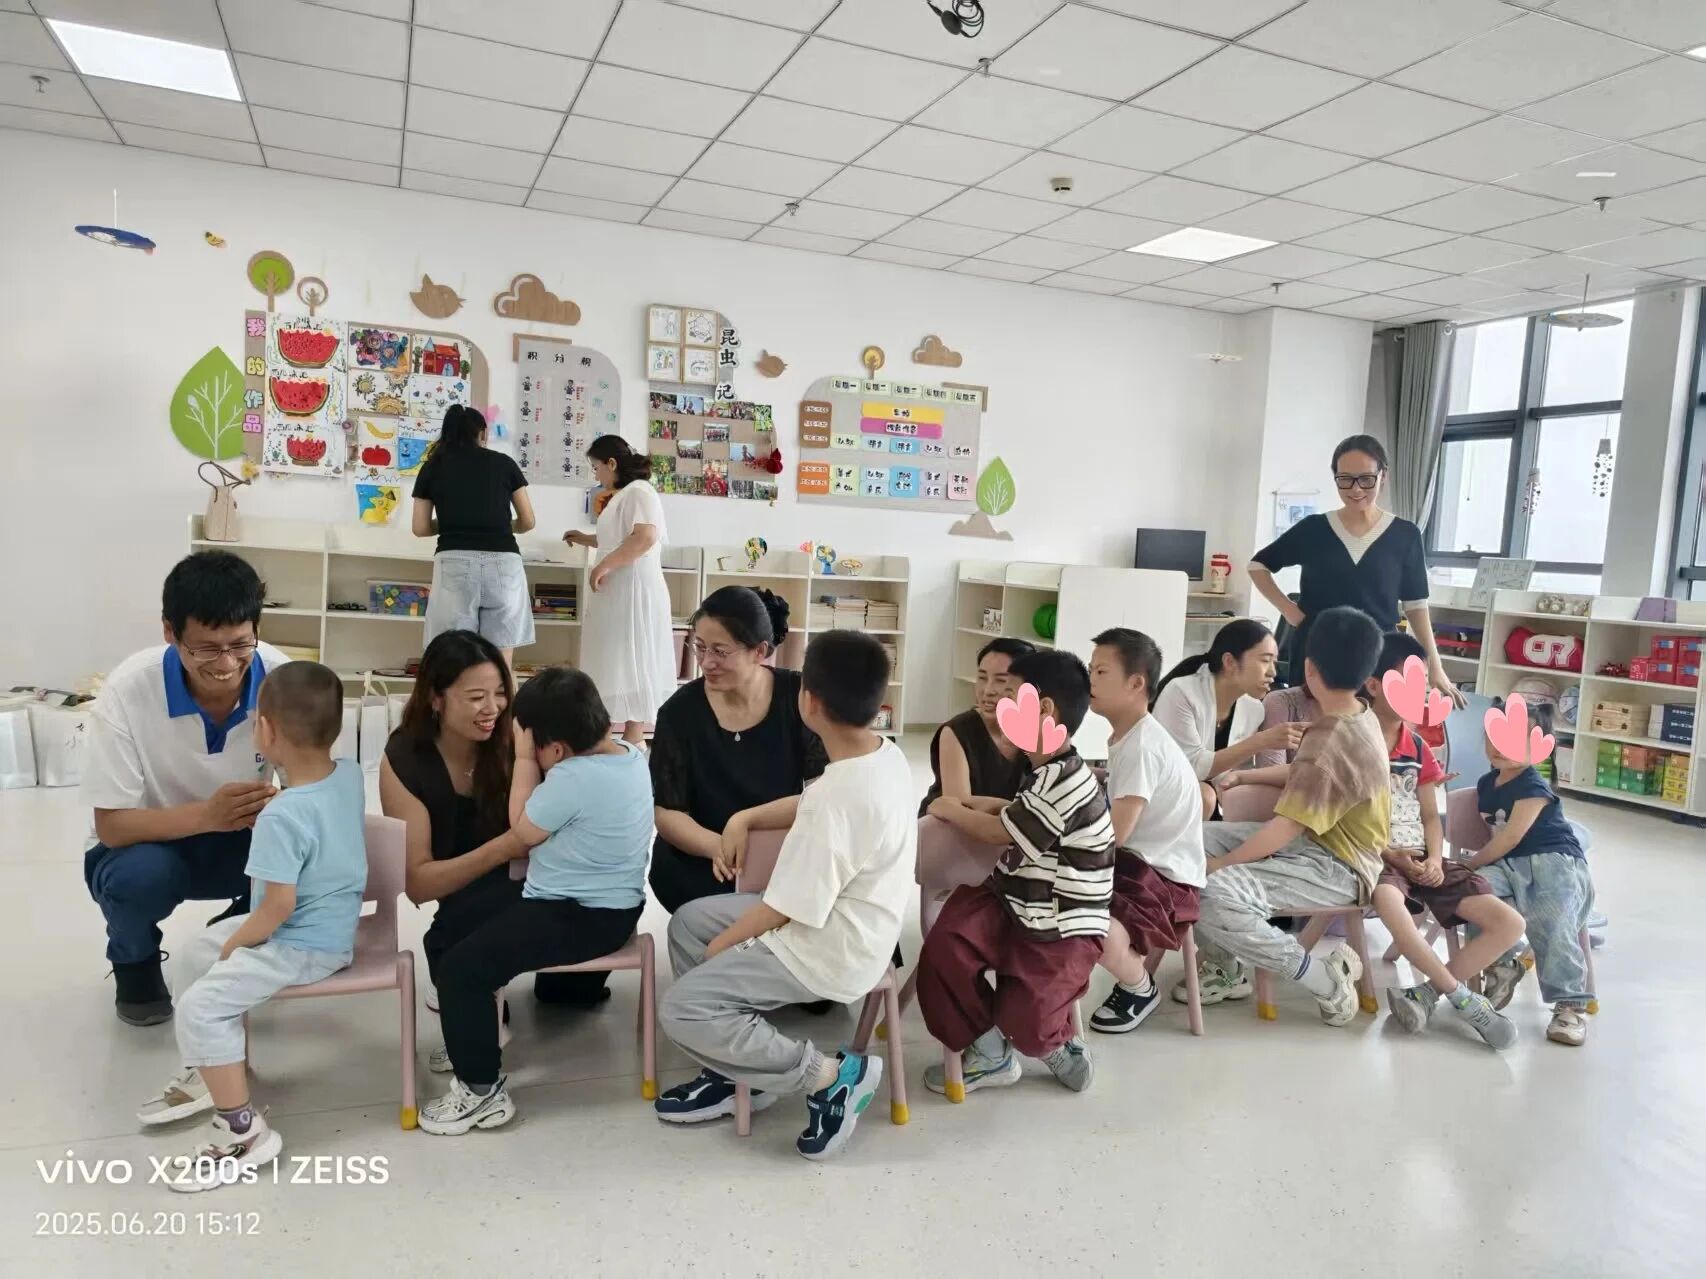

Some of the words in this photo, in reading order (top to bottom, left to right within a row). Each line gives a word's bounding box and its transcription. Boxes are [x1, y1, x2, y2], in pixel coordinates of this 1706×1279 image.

[242, 317, 266, 433] 我的作品
[716, 328, 739, 401] 昆虫记
